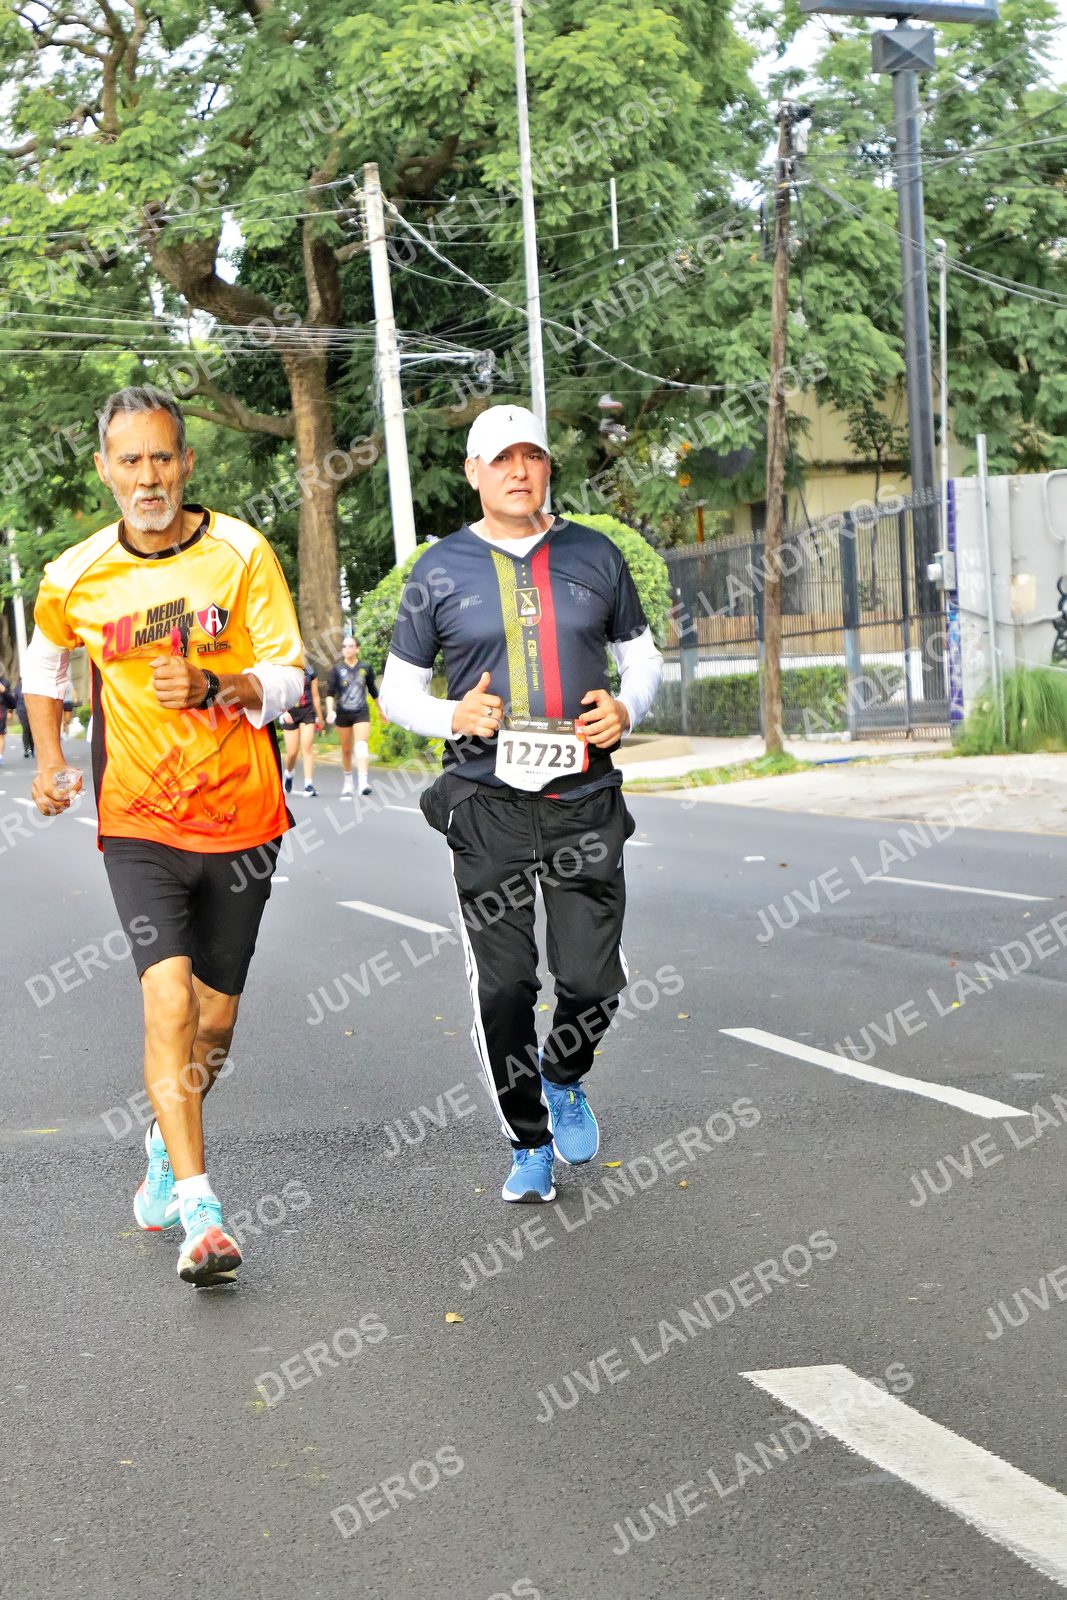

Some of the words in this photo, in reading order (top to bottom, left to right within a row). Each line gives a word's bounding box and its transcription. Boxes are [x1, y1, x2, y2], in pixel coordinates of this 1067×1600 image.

[146, 597, 185, 626] MEDIO
[134, 611, 194, 648] MARATON
[503, 740, 577, 768] 12723
